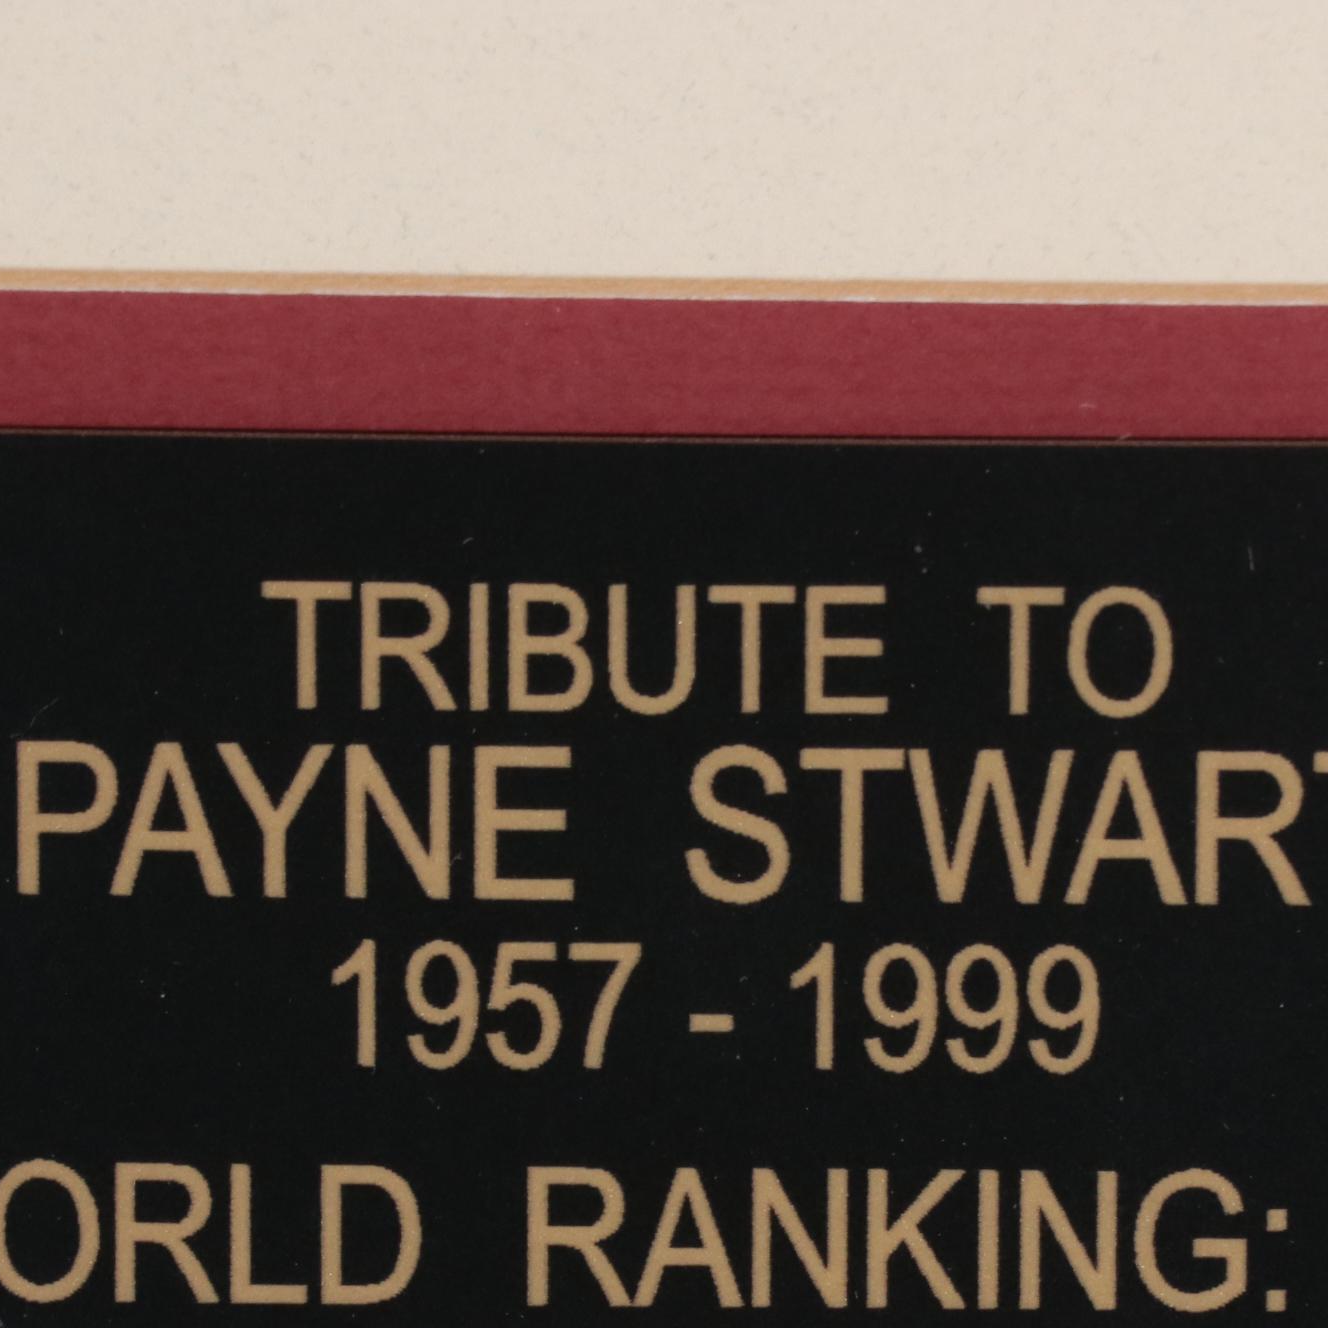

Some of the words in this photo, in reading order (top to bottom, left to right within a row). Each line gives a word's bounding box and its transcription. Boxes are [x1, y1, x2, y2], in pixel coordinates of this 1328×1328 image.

[260, 579, 889, 717] TRIBUTE
[975, 584, 1174, 720] TO
[16, 739, 576, 902] PAYNE
[331, 937, 643, 1072] 1957
[688, 1012, 735, 1034] -
[789, 941, 1102, 1076] 1999
[525, 1165, 1289, 1314] RANKING:
